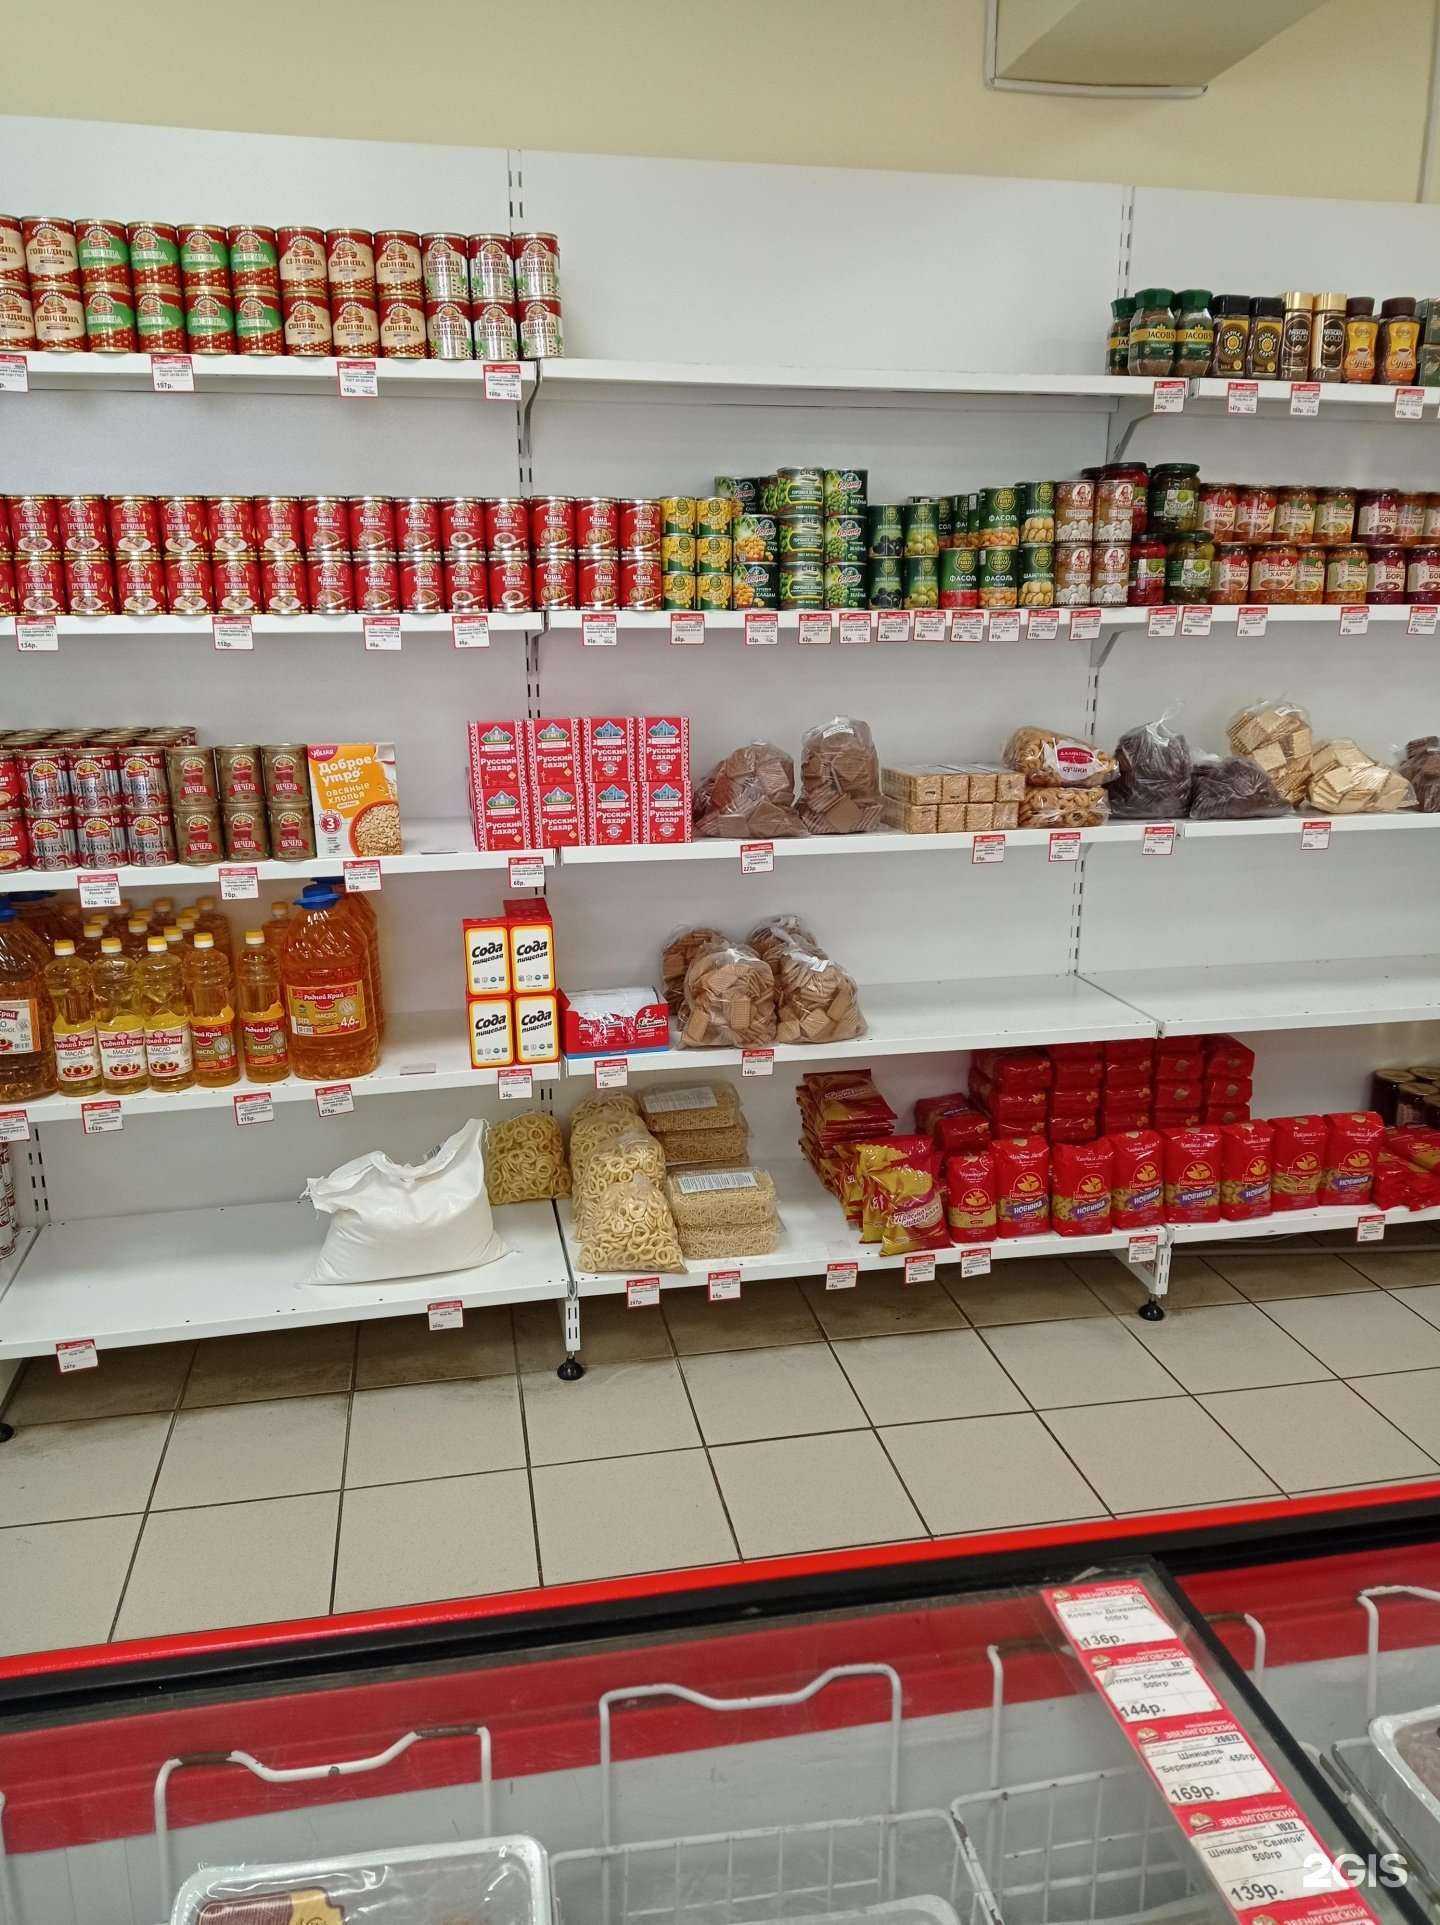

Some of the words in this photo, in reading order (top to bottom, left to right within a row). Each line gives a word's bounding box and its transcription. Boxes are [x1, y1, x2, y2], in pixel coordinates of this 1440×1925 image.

[1147, 330, 1175, 339] JACOBS
[1184, 330, 1213, 340] JACOBS
[592, 748, 627, 756] Русский
[646, 747, 681, 755] Русский
[481, 757, 517, 765] Русский
[537, 755, 573, 763] Русский
[597, 754, 622, 762] сахар
[651, 753, 676, 761] сахар
[318, 755, 372, 776] Доброе
[486, 763, 513, 772] сахар
[542, 761, 568, 769] сахар
[321, 768, 364, 786] утро
[596, 810, 631, 819] Русский
[650, 810, 684, 818] Русский
[326, 818, 335, 829] 3
[486, 821, 522, 829] Русский
[542, 818, 578, 826] Русский
[601, 816, 627, 825] сахар
[655, 816, 680, 824] сахар
[492, 827, 518, 836] сахар
[547, 823, 573, 832] сахар
[472, 941, 504, 959] Сода
[516, 940, 548, 957] Сода
[471, 953, 504, 966] пищевая
[516, 951, 548, 963] пищевая
[475, 1014, 507, 1030] Сода
[521, 1010, 552, 1027] Сода
[475, 1025, 507, 1037] пищевая
[521, 1021, 552, 1033] пищевая
[1082, 1634, 1125, 1648] 136р.
[1120, 1702, 1166, 1718] 144р.
[1171, 1785, 1220, 1802] 169р.
[1219, 1808, 1298, 1827] ЗВЕНИГОВСКИЙ
[1207, 1844, 1258, 1858] Шницель
[1231, 1882, 1284, 1902] 139р.
